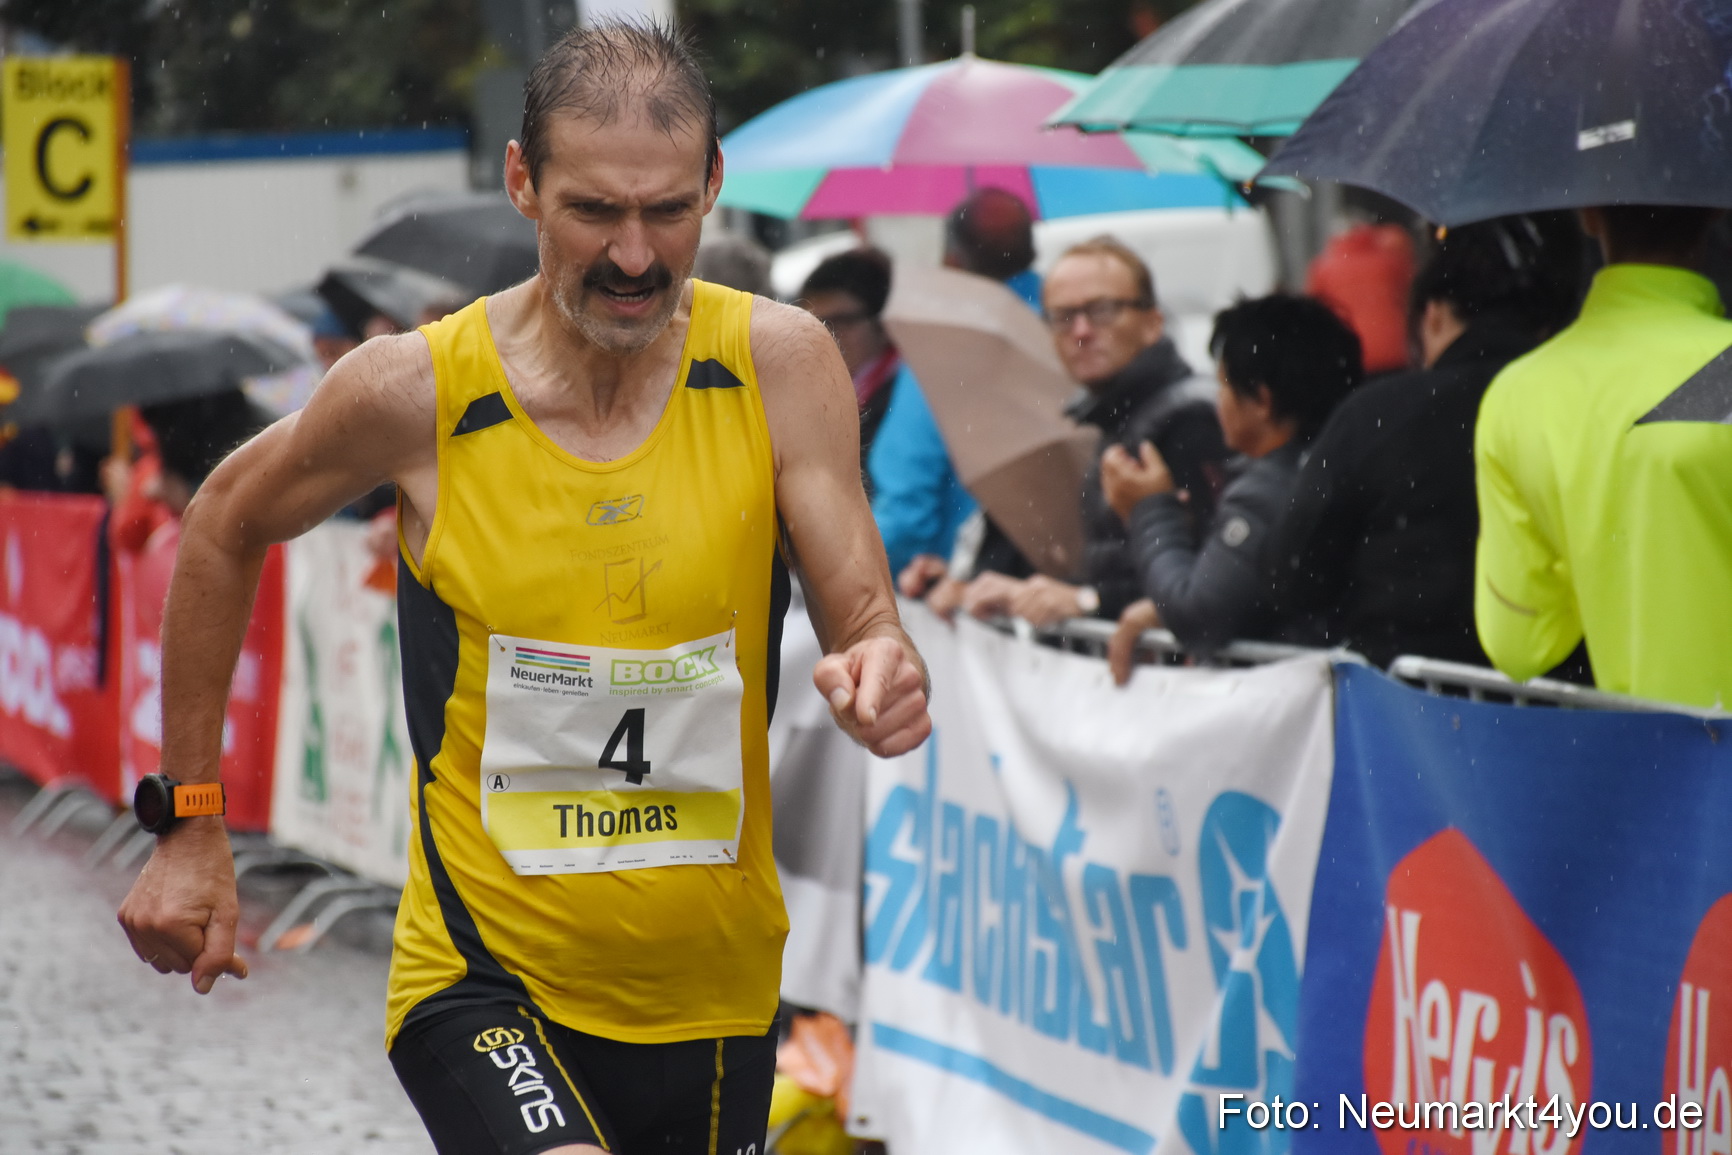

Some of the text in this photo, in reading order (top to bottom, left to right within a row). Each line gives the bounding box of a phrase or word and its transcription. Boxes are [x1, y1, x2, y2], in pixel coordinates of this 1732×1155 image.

[36, 116, 92, 204] C
[569, 534, 670, 561] FONDSZENTRUM
[600, 622, 671, 645] NEUMARKT
[510, 666, 594, 688] NeuerMarkt
[610, 645, 720, 686] BOCK
[609, 675, 725, 697] inspired by smart concepts
[598, 708, 651, 785] 4
[493, 775, 504, 790] A
[553, 804, 678, 838] Thomas
[489, 1044, 566, 1133] SKINS
